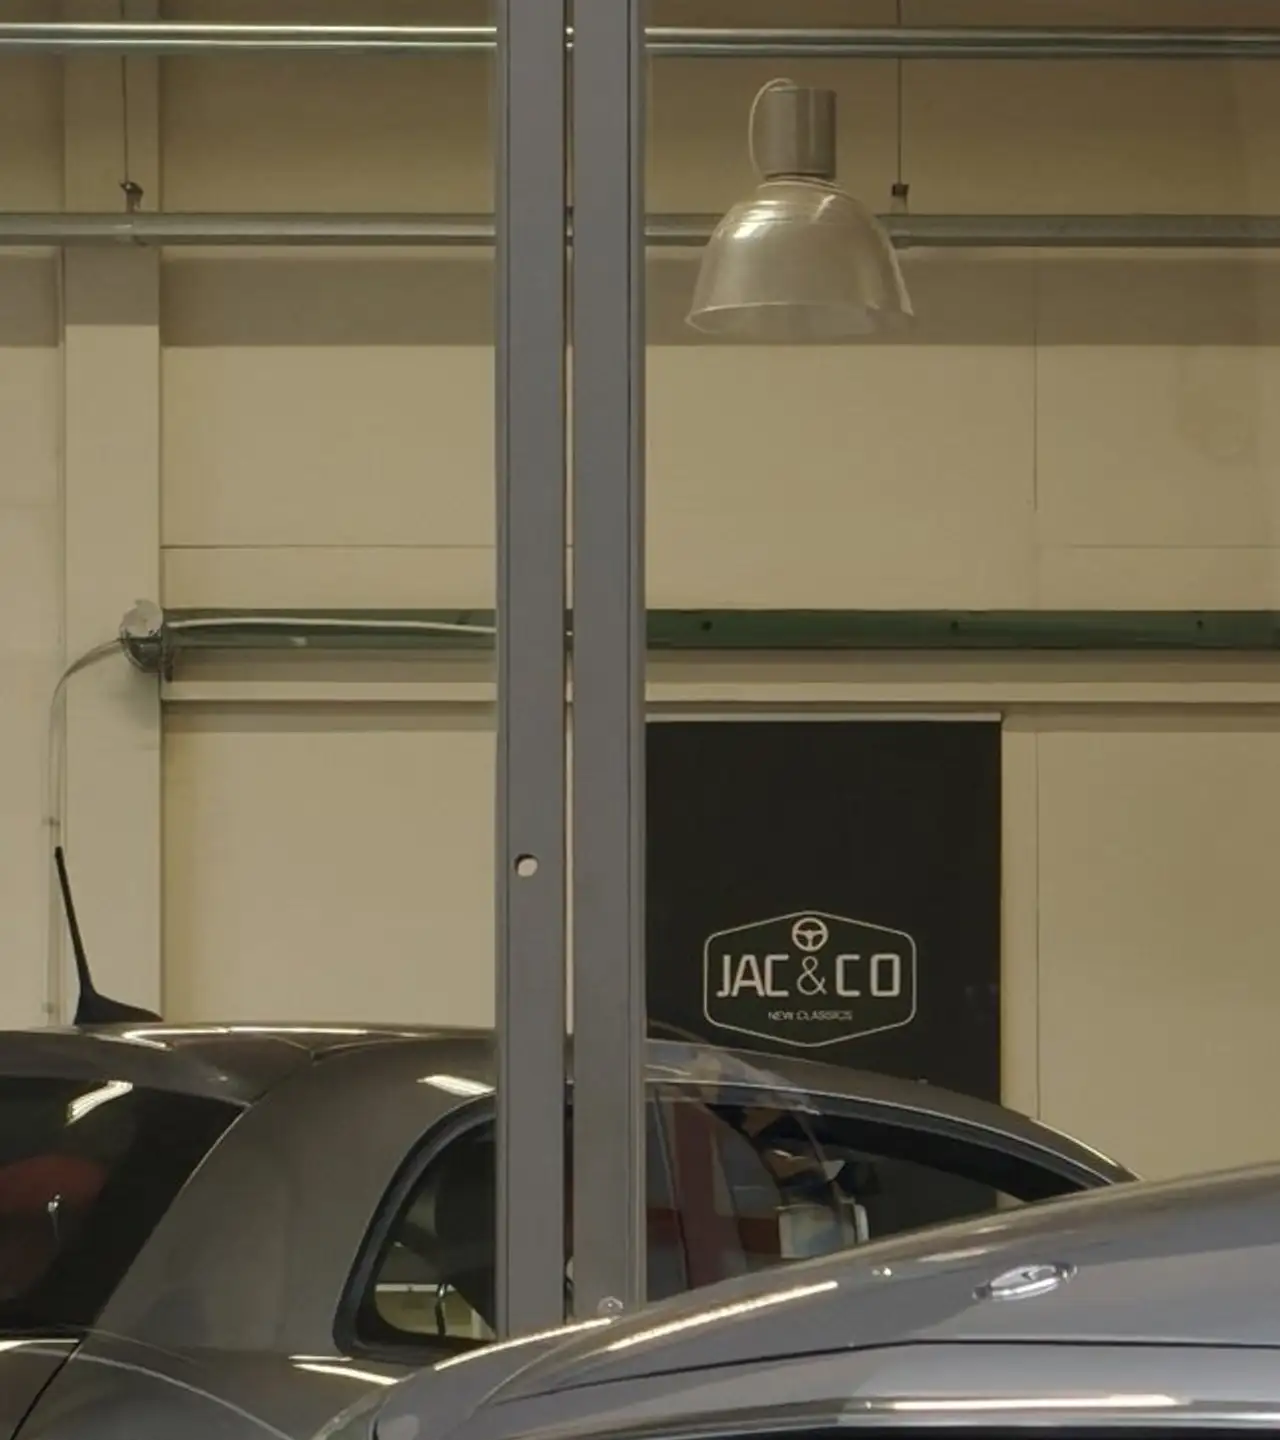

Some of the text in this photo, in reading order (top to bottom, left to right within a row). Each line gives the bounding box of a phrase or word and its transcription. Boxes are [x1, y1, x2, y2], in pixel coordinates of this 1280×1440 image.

[716, 953, 901, 997] JAC & CO
